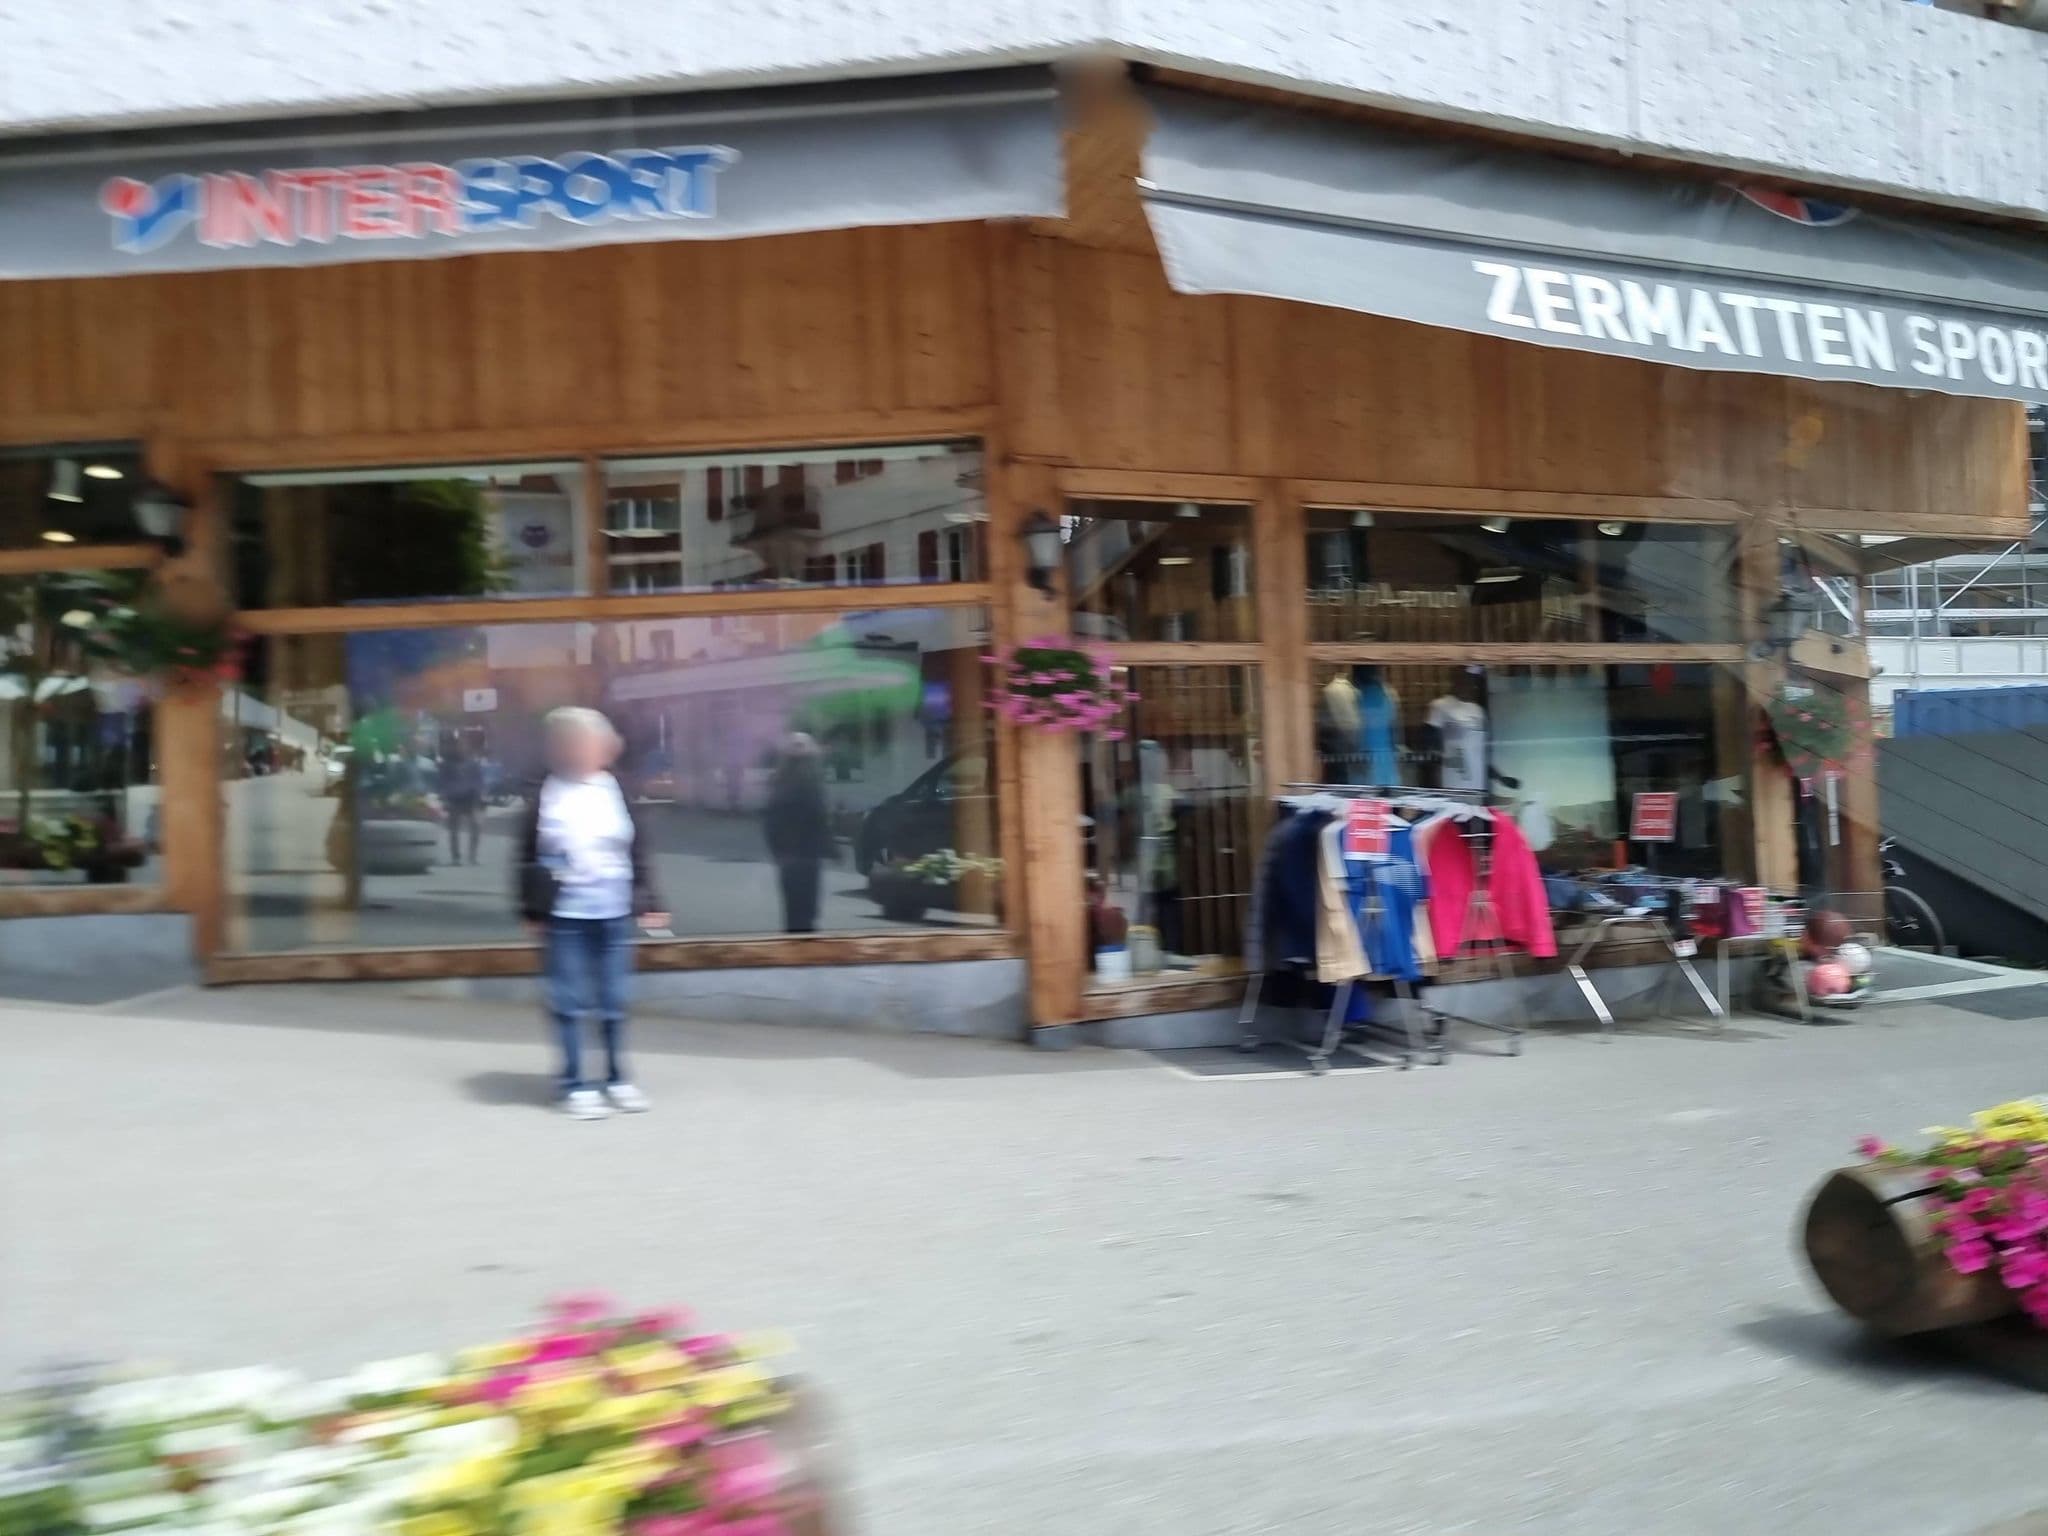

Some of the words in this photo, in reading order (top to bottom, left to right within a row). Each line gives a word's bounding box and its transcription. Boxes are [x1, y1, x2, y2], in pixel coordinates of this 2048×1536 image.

[195, 145, 738, 247] INTERSPORT
[1472, 260, 1896, 372] ZERMATTEN
[1904, 315, 2048, 390] SPOR
